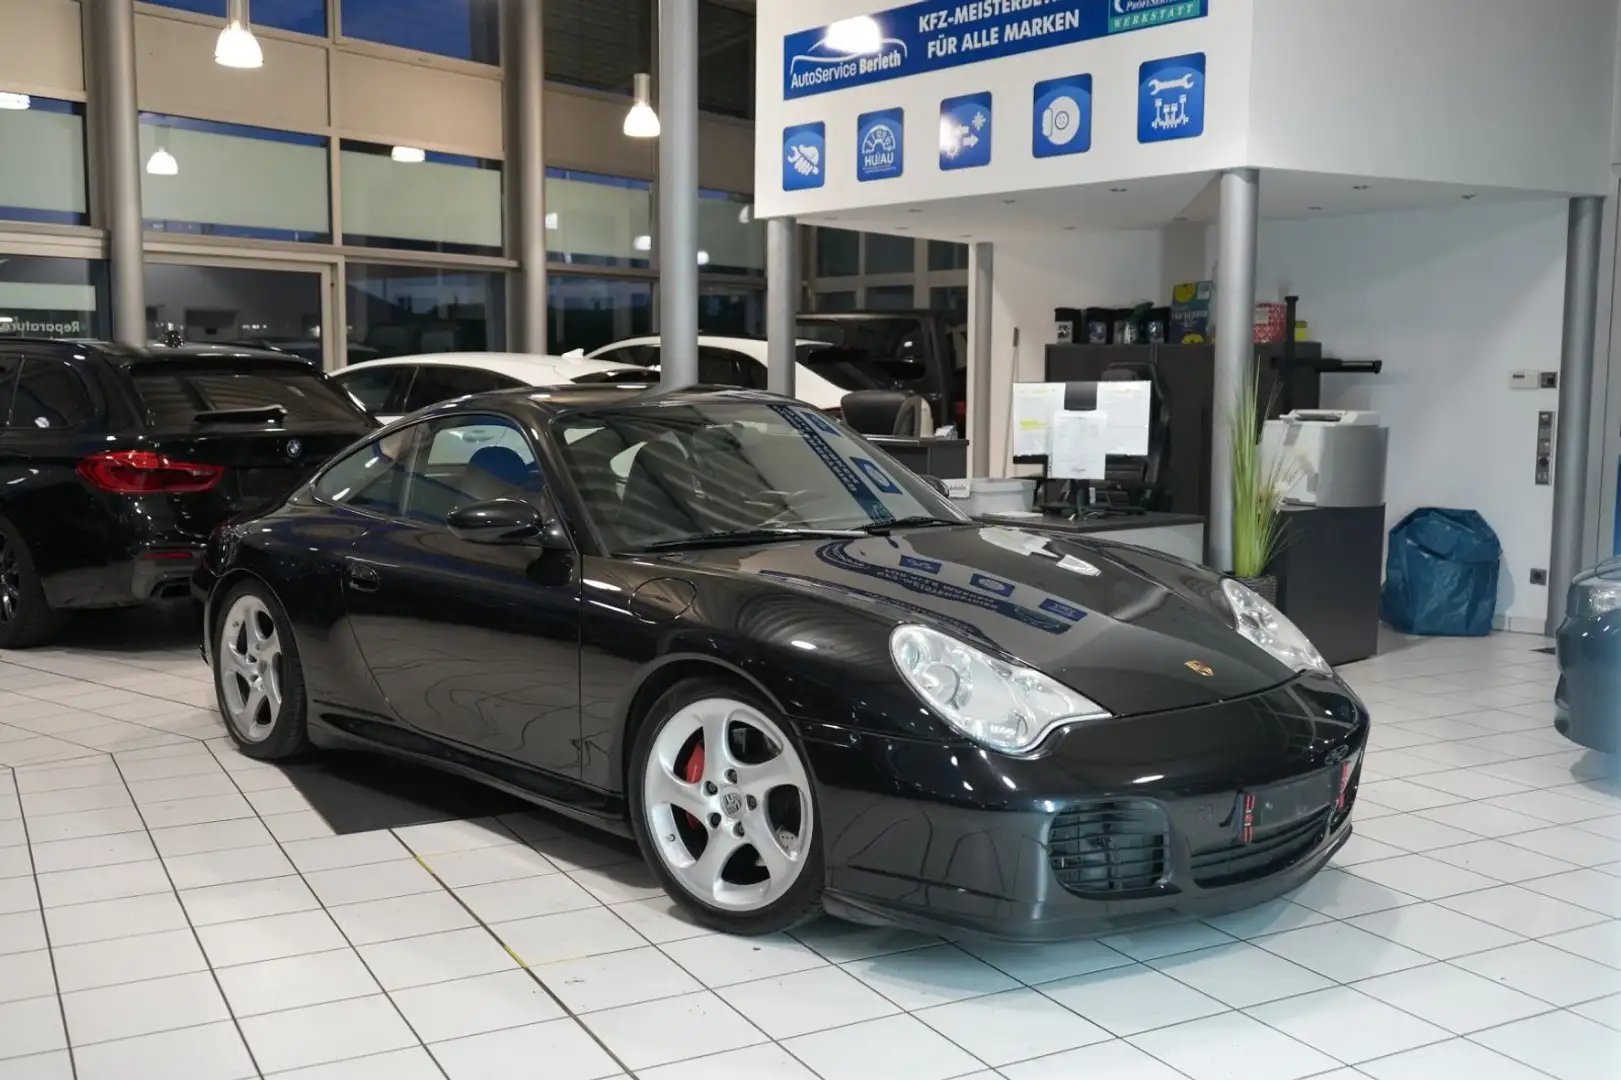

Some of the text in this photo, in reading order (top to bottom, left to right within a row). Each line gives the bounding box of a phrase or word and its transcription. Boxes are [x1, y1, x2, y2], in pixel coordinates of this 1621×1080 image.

[928, 9, 1079, 59] FÜR ALLE MARKEN
[1114, 4, 1194, 28] WERKSTATT
[791, 49, 901, 89] AutoService Berleth
